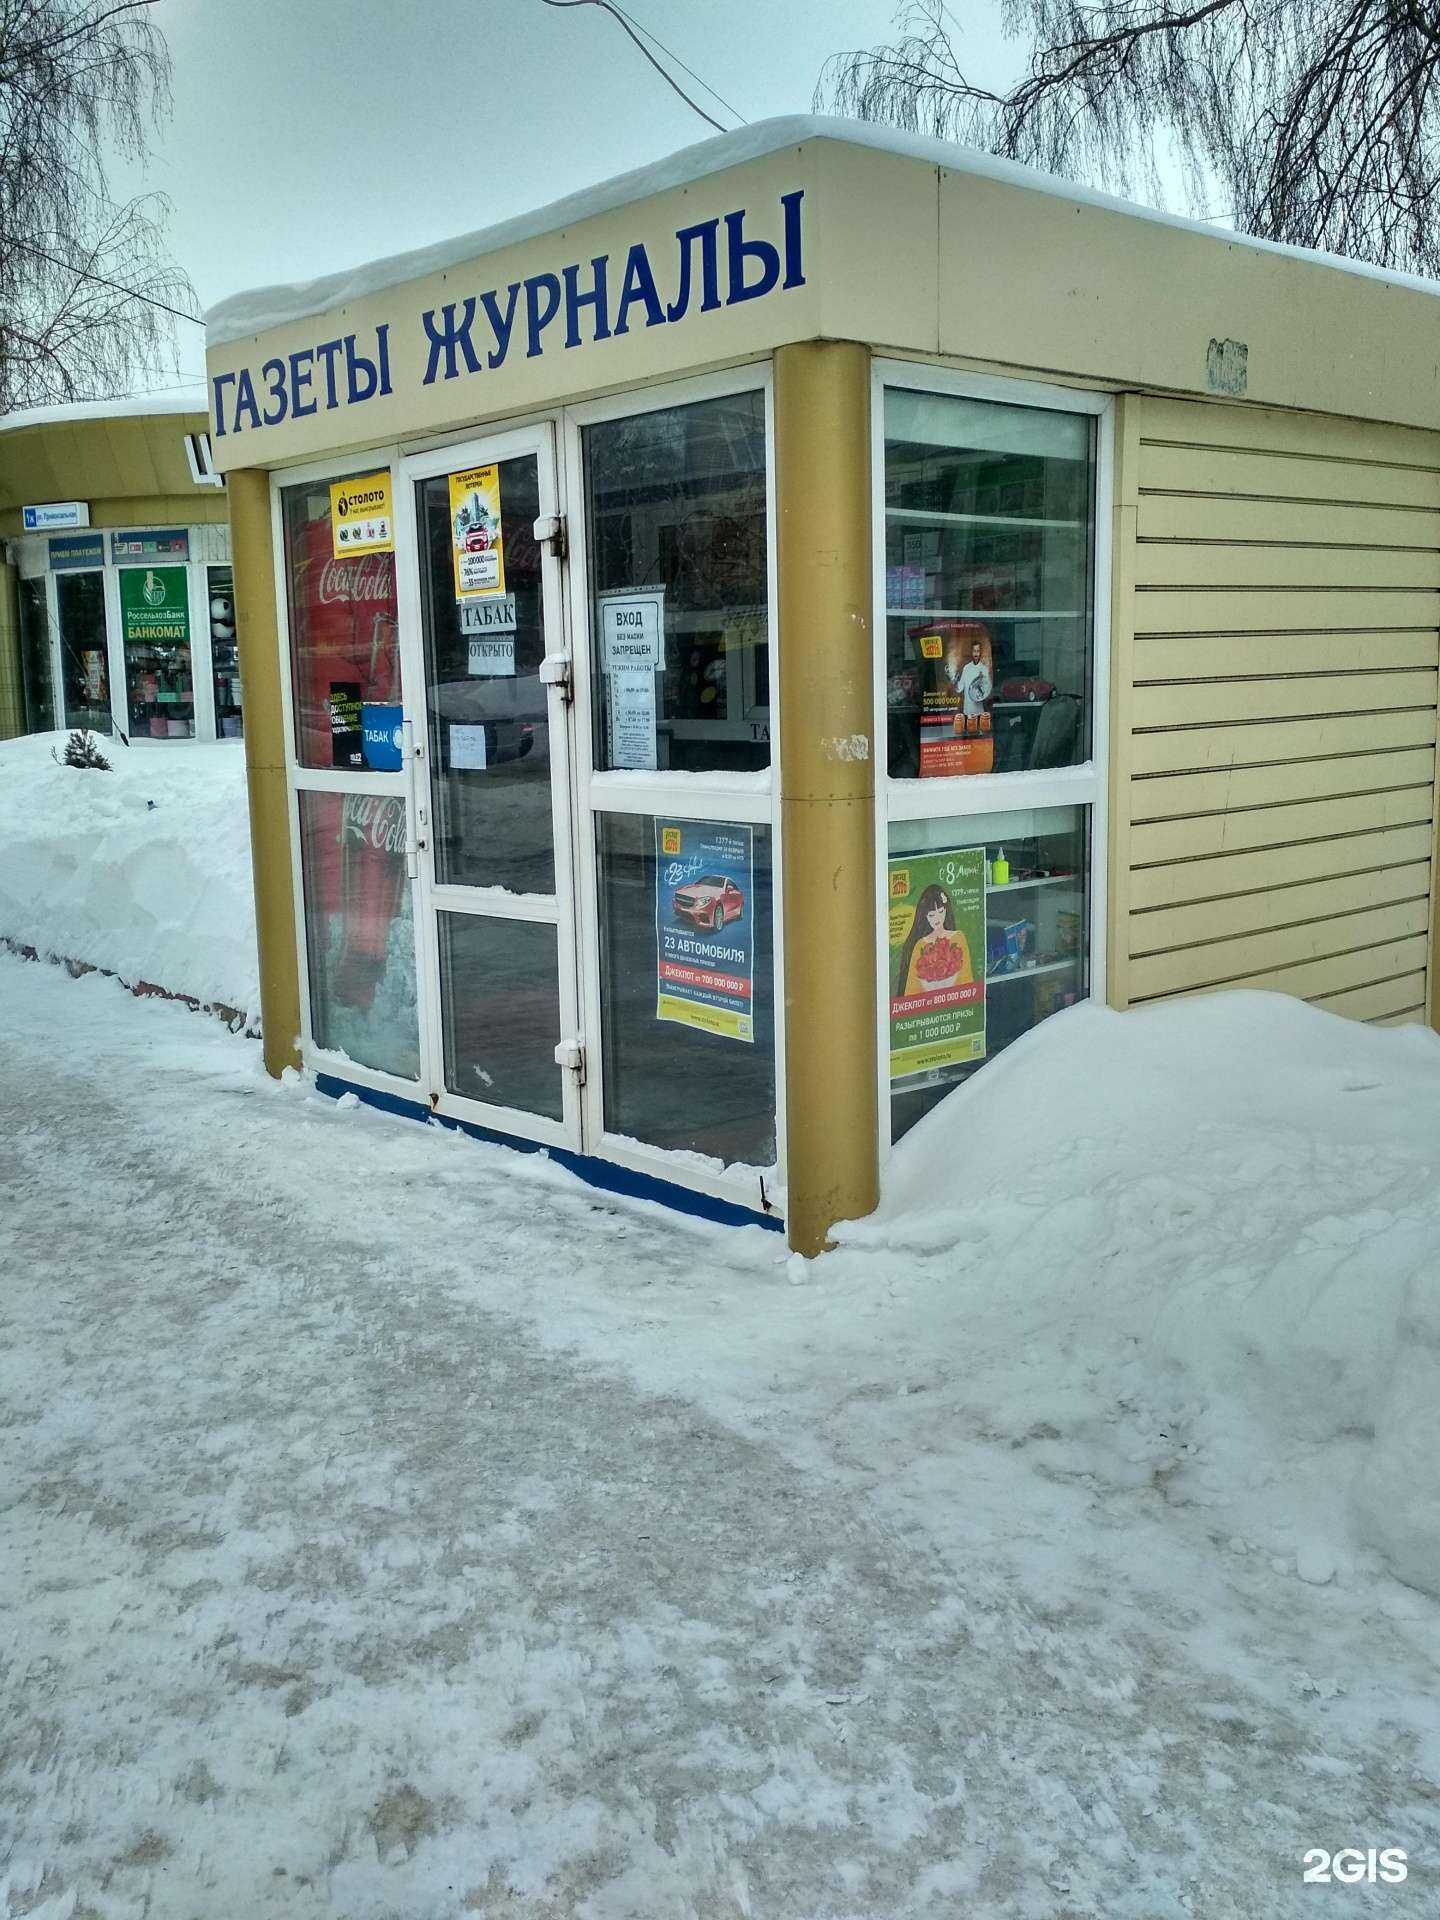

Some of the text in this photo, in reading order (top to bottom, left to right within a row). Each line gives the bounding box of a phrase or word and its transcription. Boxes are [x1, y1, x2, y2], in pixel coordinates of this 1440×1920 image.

[212, 189, 807, 438] ГАЗЕТЫ ЖУРНАЛЫ
[127, 610, 185, 620] РоссельхозБанк
[463, 604, 513, 627] ТАБАК
[616, 611, 643, 628] ВХОД
[127, 625, 186, 638] БАНКОМАТ
[627, 632, 645, 640] МАСКИ
[470, 644, 513, 658] ОТКРЫТО
[612, 644, 651, 656] ЗАПРЕЩЕН
[364, 729, 389, 743] ТАБАК
[946, 861, 955, 884] 8
[664, 935, 745, 964] 23 АВТОМОБИЛЯ
[665, 965, 695, 981] ДЖЕКПОТ
[892, 998, 925, 1014] ДЖЕКПОТ
[933, 995, 946, 1005] 800
[946, 992, 959, 1001] 000
[959, 989, 972, 999] 000
[895, 1008, 974, 1031] РАЗЫГРЫВАЮТСЯ ПРИЗЫ
[919, 1030, 923, 1039] 1
[925, 1027, 939, 1037] 000
[940, 1024, 954, 1035] 000
